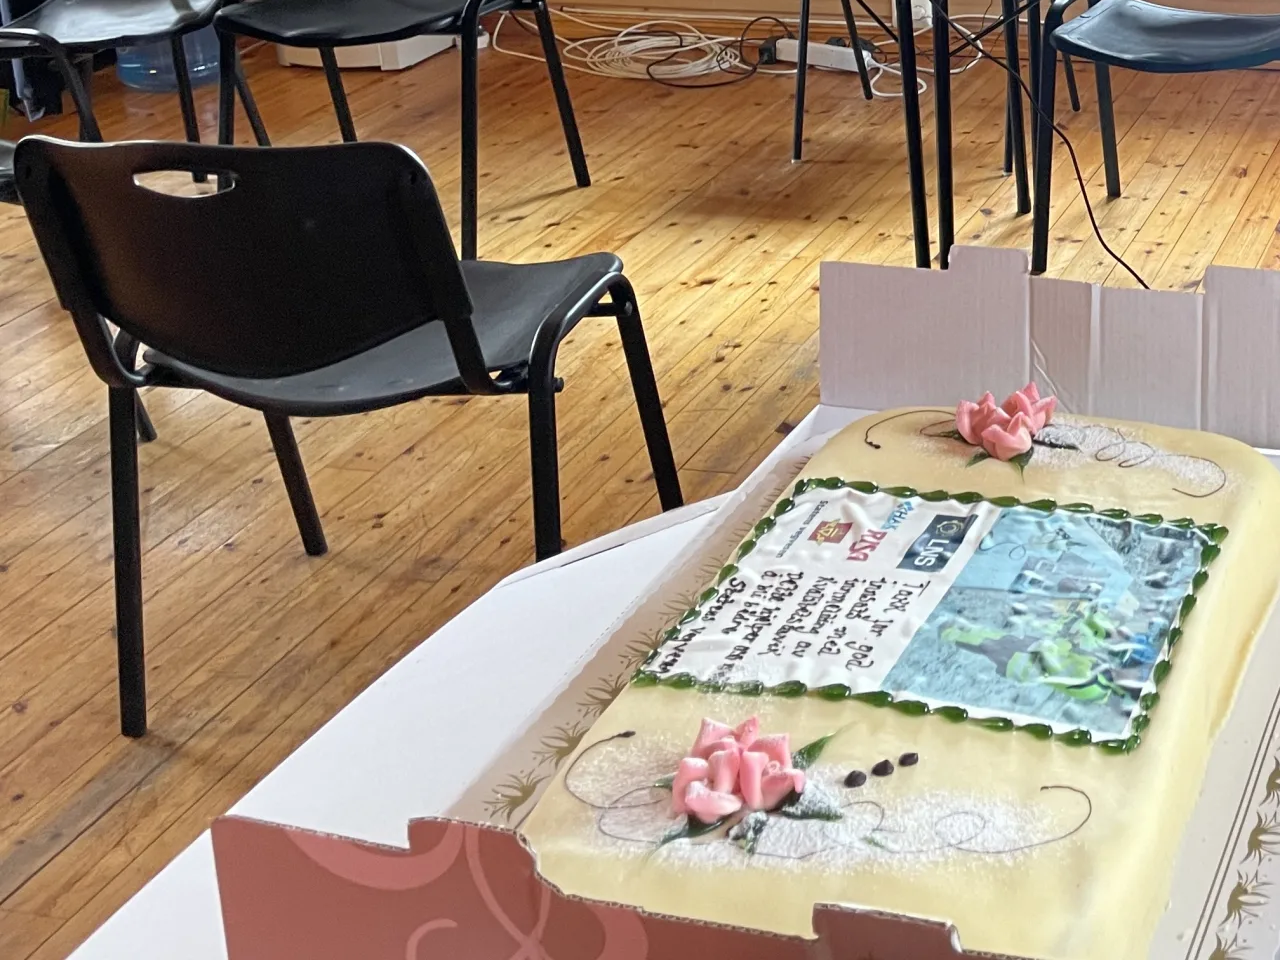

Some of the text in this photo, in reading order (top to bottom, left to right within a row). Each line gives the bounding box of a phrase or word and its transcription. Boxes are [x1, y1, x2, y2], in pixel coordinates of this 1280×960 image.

[846, 529, 887, 561] RISA
[915, 540, 950, 567] LNS
[792, 641, 811, 658] av
[818, 626, 847, 656] med
[844, 641, 874, 671] god
